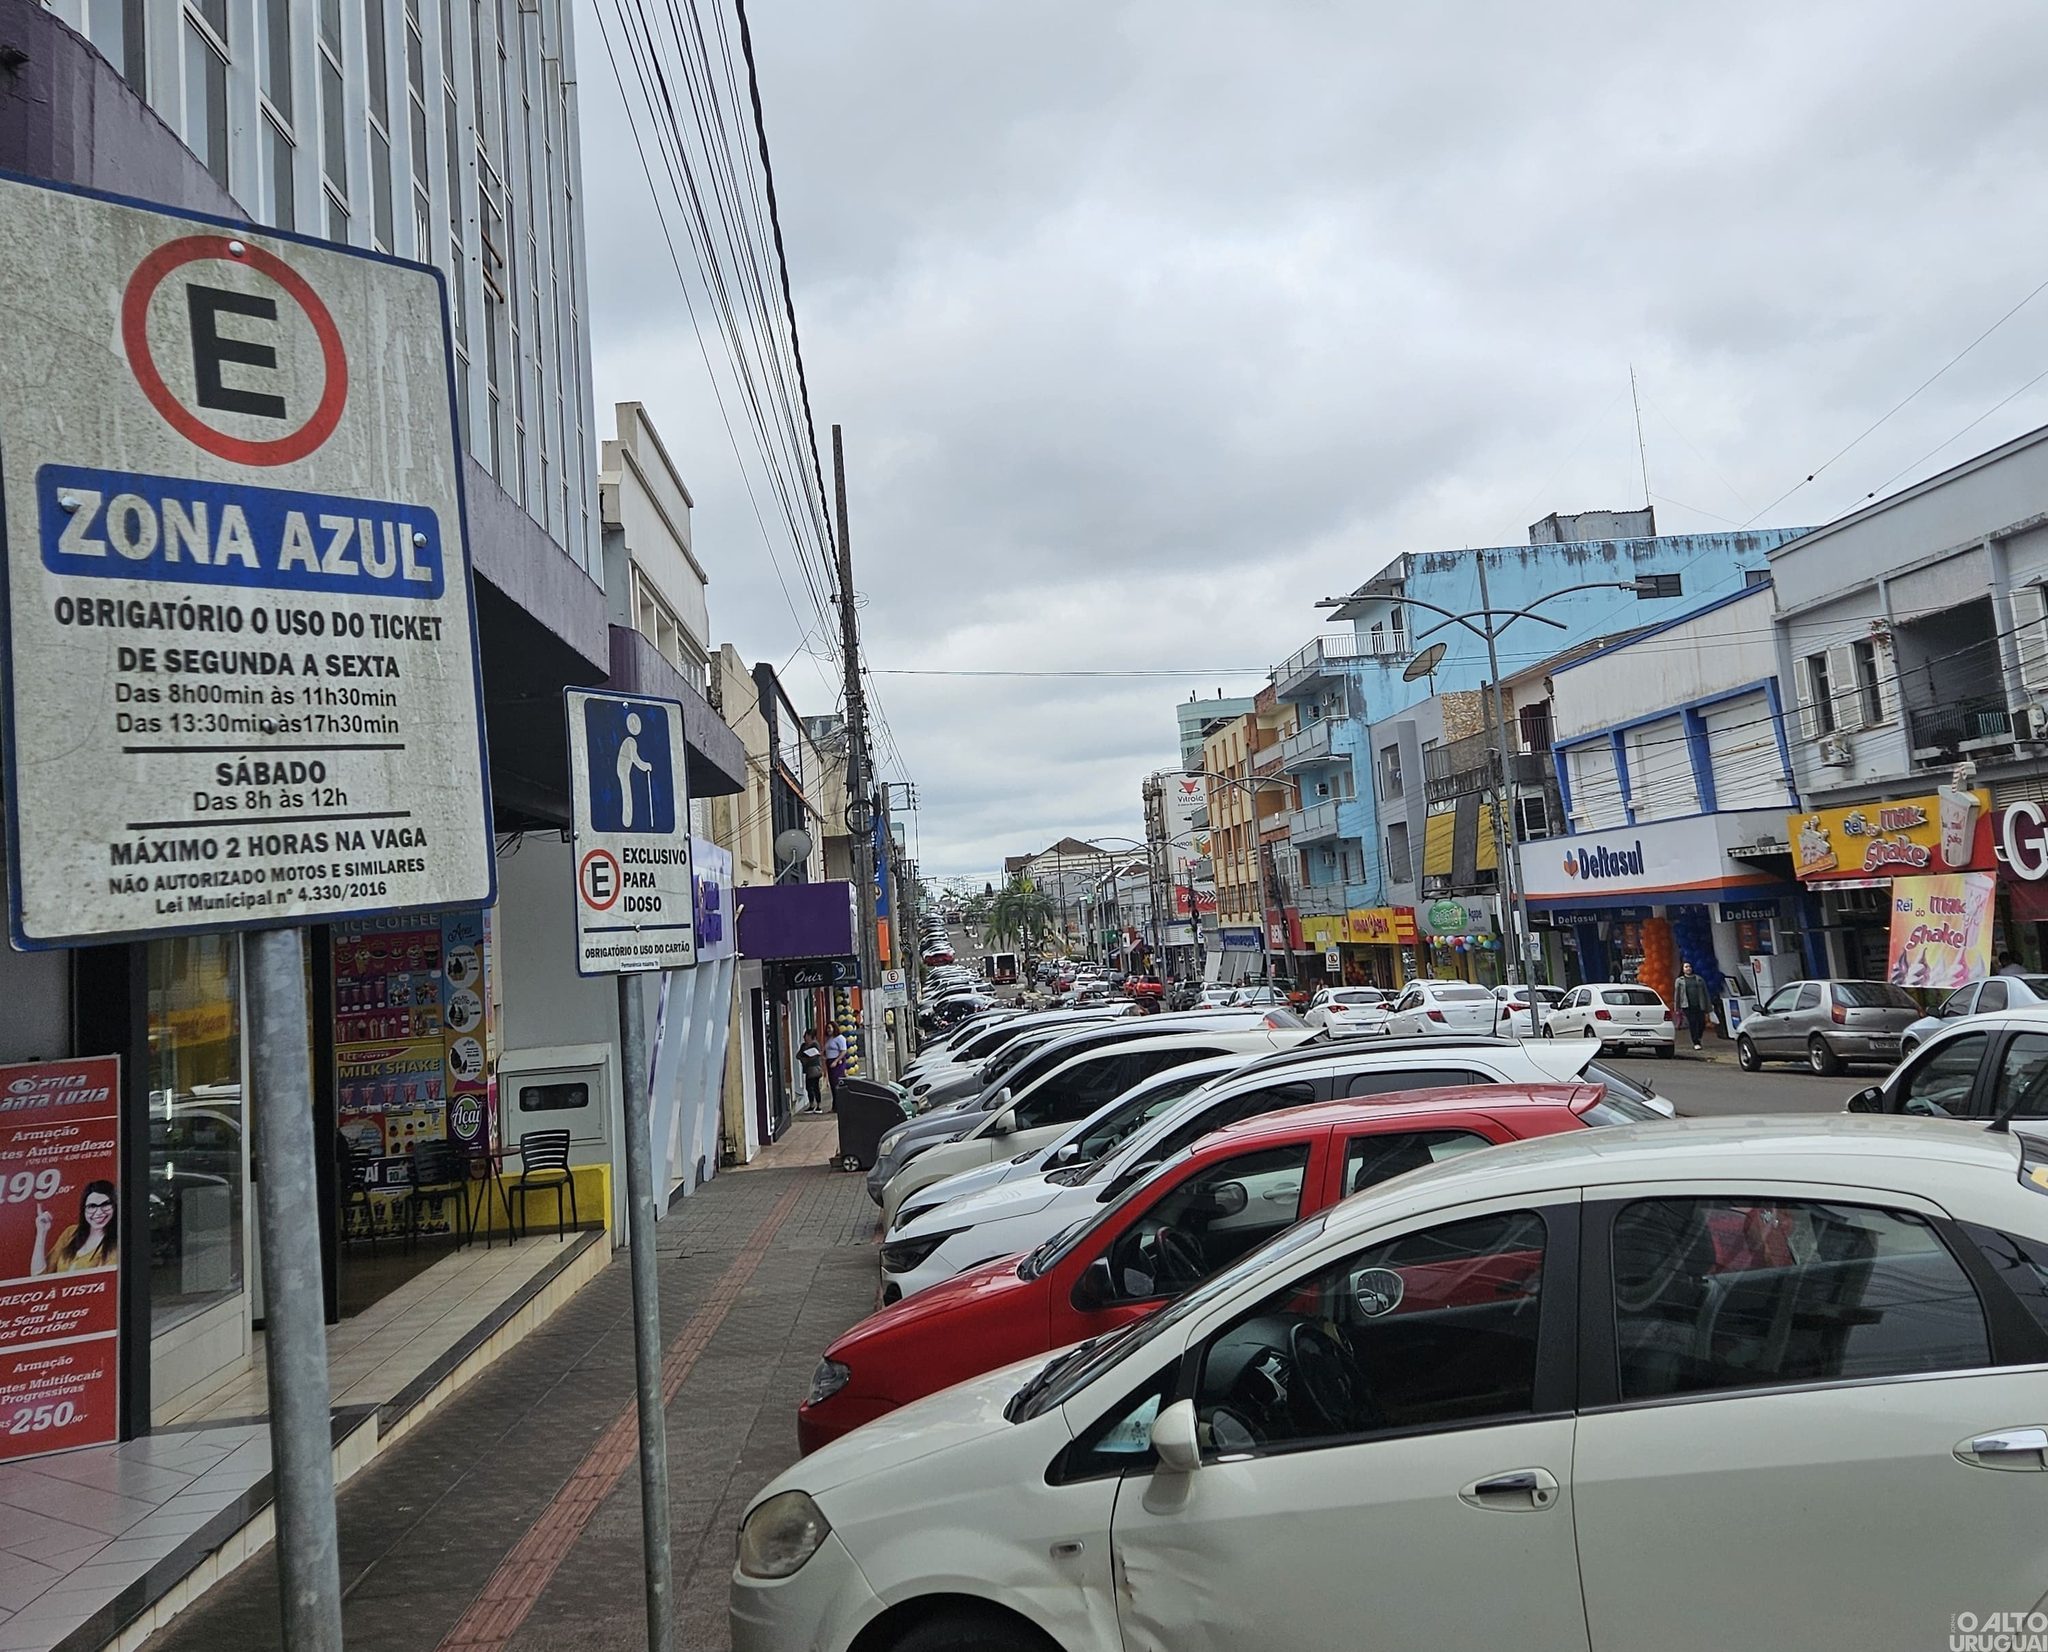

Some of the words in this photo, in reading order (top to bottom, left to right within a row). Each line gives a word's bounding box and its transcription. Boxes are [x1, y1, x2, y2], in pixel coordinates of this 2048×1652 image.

[186, 282, 287, 419] E
[57, 487, 261, 569] ZONA
[277, 511, 433, 582] AZUL
[54, 595, 243, 634] OBRIGATÓRIO
[251, 607, 268, 634] O
[276, 609, 325, 637] USO
[332, 612, 365, 638] DO
[371, 614, 442, 641] TICKET
[118, 646, 156, 672] DE
[164, 648, 295, 676] SEGUNDA
[302, 653, 319, 677] A
[325, 653, 400, 678] SEXTA
[115, 682, 161, 703] Das
[168, 683, 264, 704] 8h00min
[271, 685, 295, 705] às
[302, 686, 397, 707] 11h30min
[116, 712, 161, 733] Das
[216, 755, 326, 787] SÁBADO
[194, 790, 238, 811] Das
[245, 789, 272, 810] 8h
[279, 788, 304, 809] às
[311, 787, 348, 807] 12h
[110, 835, 219, 866] MÁXIMO
[226, 836, 241, 859] 2
[248, 831, 329, 857] HORAS
[335, 829, 366, 852] NA
[371, 827, 428, 850] VAGA
[622, 847, 687, 865] EXCLUSIVO
[1578, 840, 1644, 880] Deltasul
[109, 873, 149, 895] NÃO
[154, 867, 266, 892] AUTORIZADO
[270, 864, 327, 883] MOTOS
[331, 863, 341, 878] E
[344, 857, 425, 877] SIMILARES
[591, 861, 611, 898] E
[622, 871, 656, 888] PARA
[155, 896, 183, 915] Lei
[187, 888, 272, 912] Municipal
[298, 881, 387, 902] 4.330/2016
[623, 895, 662, 913] IDOSO
[1896, 898, 1913, 912] Rei
[1558, 912, 1598, 925] Deltasul
[1726, 906, 1776, 921] Deltasul
[585, 944, 632, 959] OBRIGATÓRIO
[633, 945, 639, 956] O
[640, 945, 653, 955] USO
[654, 944, 664, 954] DO
[665, 941, 690, 953] CARTÃO
[339, 1064, 381, 1079] MILK
[386, 1059, 441, 1074] SHAKE
[0, 1093, 51, 1111] ANTA
[11, 1125, 79, 1142] Armação
[0, 1150, 23, 1160] tes
[26, 1140, 115, 1157] Antirreflexo
[0, 1291, 43, 1306] REÇO
[62, 1281, 105, 1298] VISTA
[12, 1315, 45, 1328] Sem
[47, 1307, 90, 1322] Juros
[30, 1303, 50, 1314] ou
[0, 1329, 18, 1340] os
[20, 1319, 78, 1337] Cartões
[13, 1355, 74, 1374] Armação
[29, 1369, 103, 1389] Multifocais
[1, 1385, 85, 1405] Progressivas
